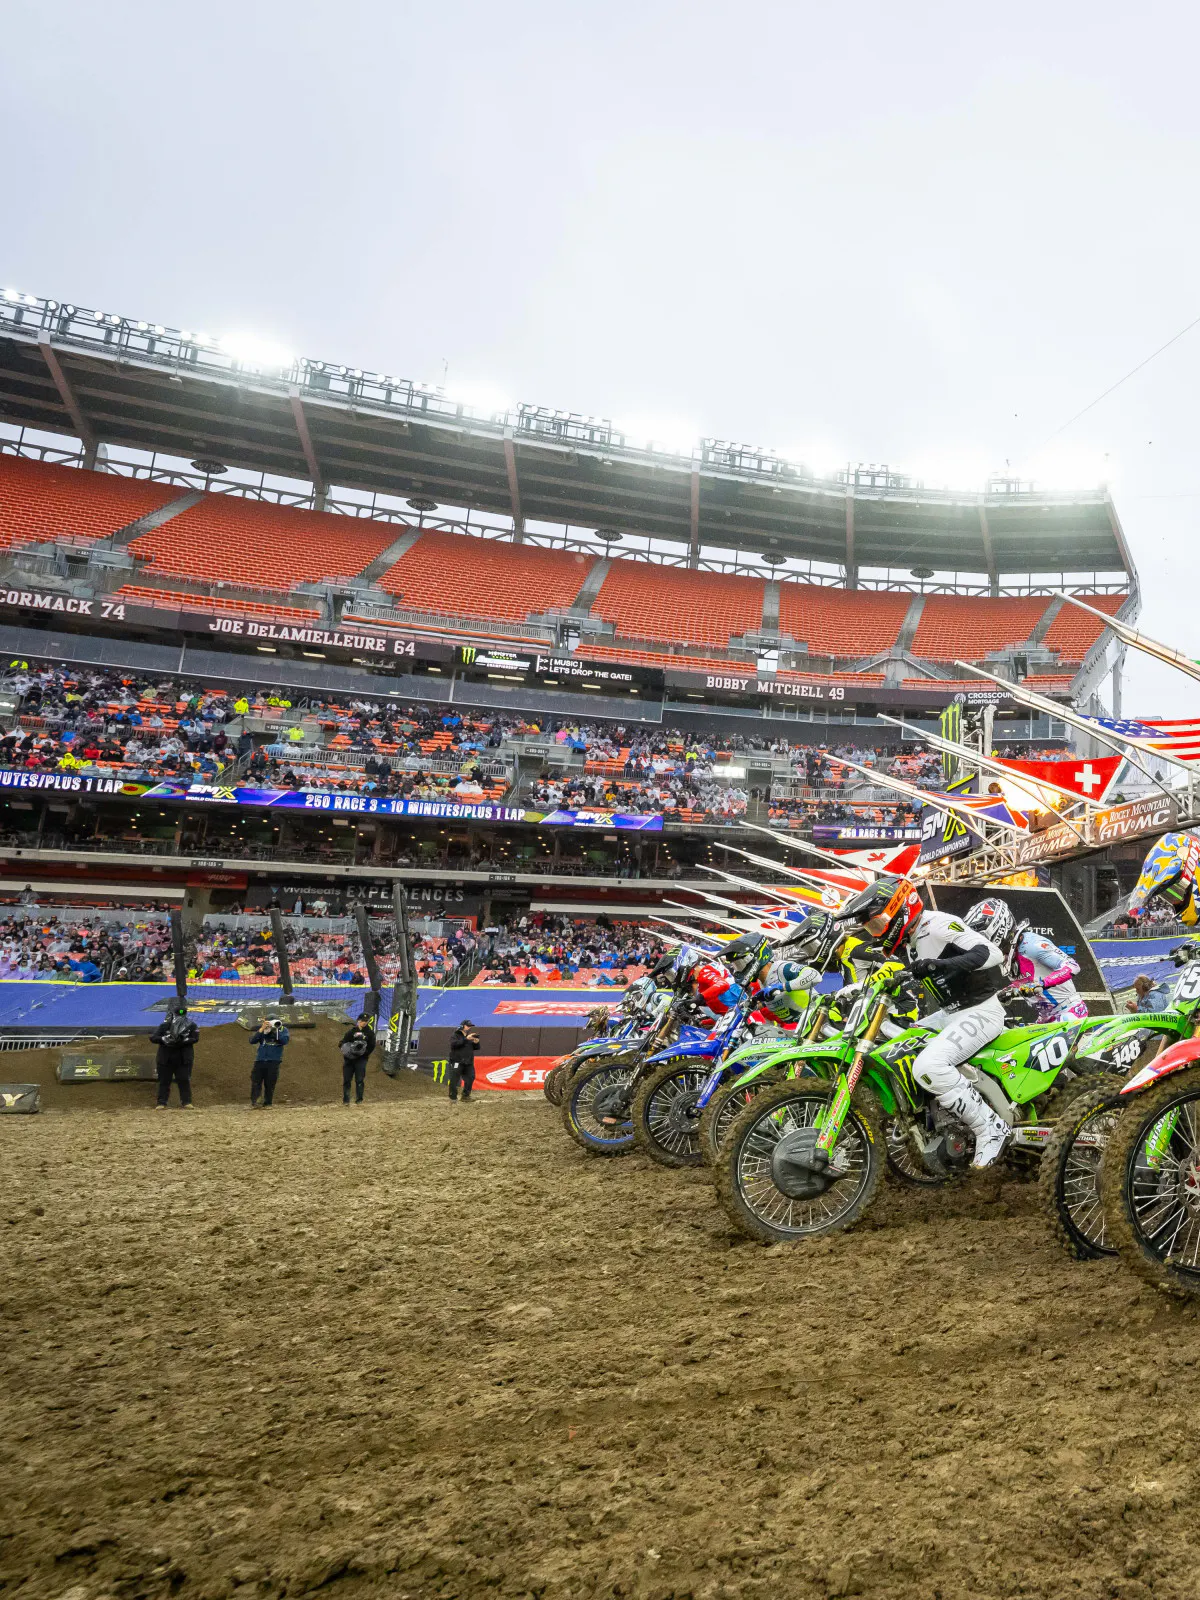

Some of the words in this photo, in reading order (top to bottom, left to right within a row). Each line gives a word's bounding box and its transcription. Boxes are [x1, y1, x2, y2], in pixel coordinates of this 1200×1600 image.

[101, 603, 125, 620] 74
[209, 618, 243, 635] JOE
[393, 640, 415, 656] 64
[549, 666, 570, 675] LET'S
[571, 668, 593, 676] DROP
[594, 670, 609, 679] THE
[610, 672, 632, 681] GATE!
[554, 660, 578, 668] MUSIC
[706, 676, 749, 691] BOBBY
[757, 681, 824, 698] MITCHELL
[828, 687, 845, 700] 49
[0, 771, 81, 791] UTES/PLUS
[86, 779, 93, 792] 1
[96, 780, 123, 794] LAP
[187, 784, 238, 799] SMX
[305, 795, 330, 808] 250
[334, 797, 365, 811] RACE
[369, 799, 377, 812] 3
[391, 801, 403, 812] 10
[408, 802, 492, 820] MINUTES/PLUS
[496, 808, 501, 820] 1
[504, 808, 525, 821] LAP
[1109, 807, 1131, 823] ROCKY
[1132, 798, 1170, 816] MOUNTAIN
[858, 828, 878, 839] RACE
[881, 829, 886, 839] 3
[934, 837, 970, 859] CHAMPIONSHIP
[346, 886, 464, 902] EXPEENCES
[889, 884, 910, 914] SCO
[1026, 926, 1055, 936] STER
[1121, 1015, 1141, 1024] SONS
[1149, 1013, 1178, 1024] FATHERS
[946, 1011, 991, 1050] FOX
[885, 1033, 932, 1059] KX
[1029, 1036, 1069, 1073] 10
[1112, 1039, 1141, 1069] 148
[847, 1059, 865, 1094] SHOWA
